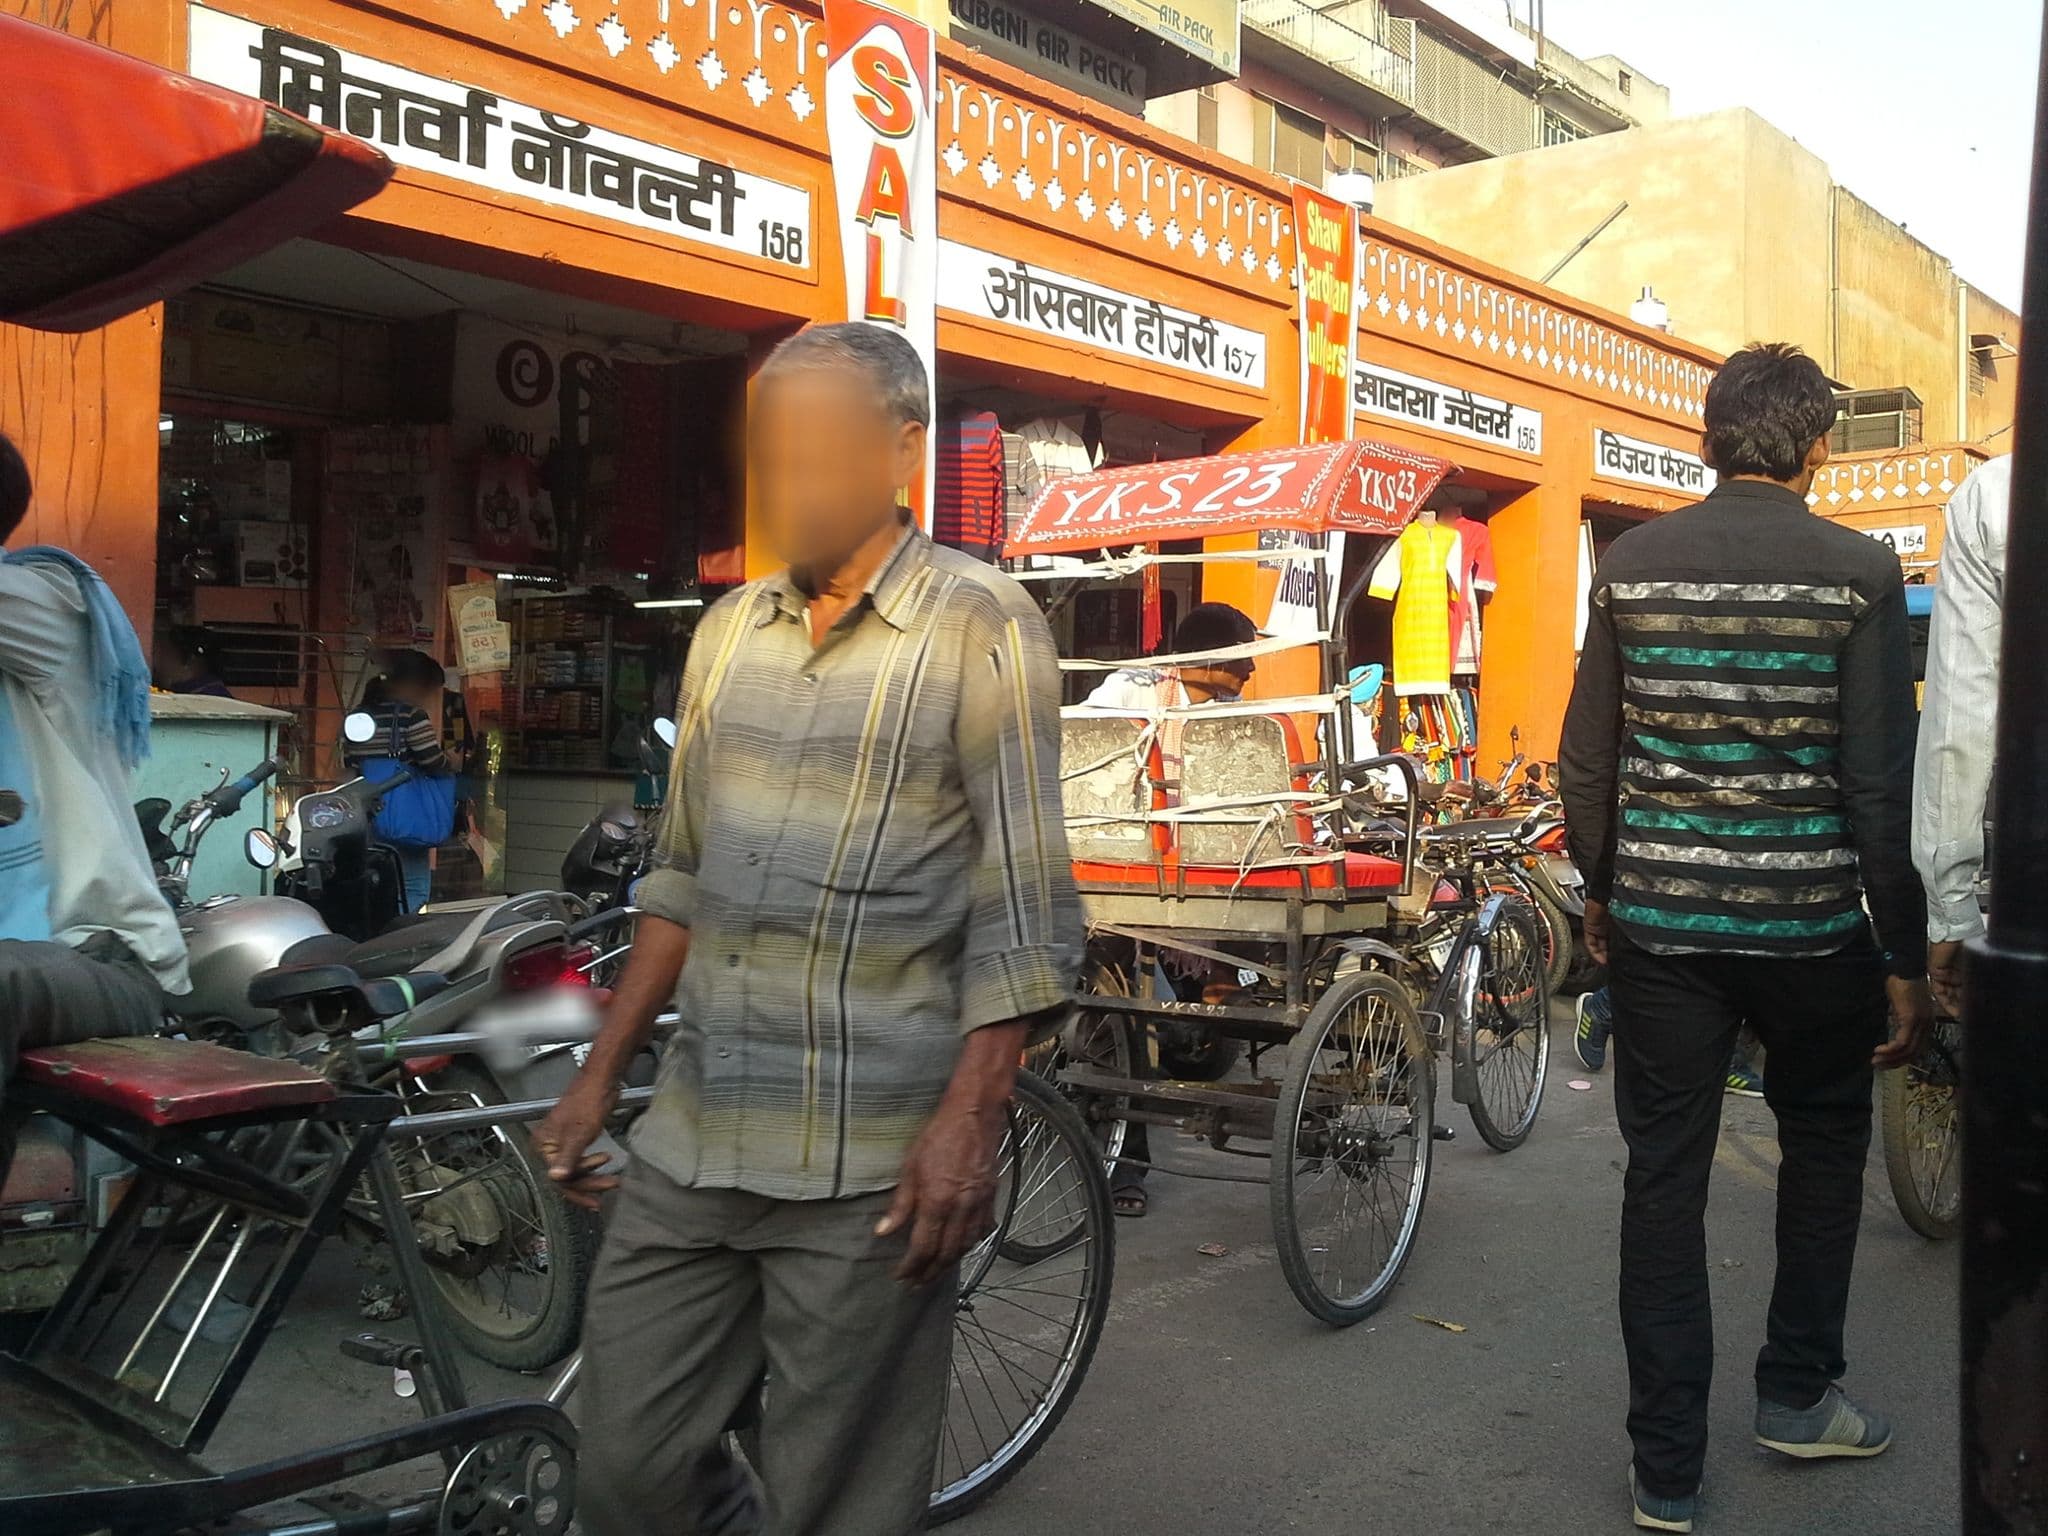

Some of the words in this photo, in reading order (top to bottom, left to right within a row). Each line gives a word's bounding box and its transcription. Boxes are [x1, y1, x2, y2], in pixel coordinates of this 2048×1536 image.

[1159, 4, 1180, 31] AIR
[1184, 16, 1214, 46] PACK
[1036, 27, 1070, 68] AIR
[1078, 46, 1135, 96] PACK
[758, 219, 803, 264] 158
[1306, 200, 1342, 256] Shaw
[1223, 344, 1257, 378] 157
[1354, 370, 1439, 421] खालसा
[1517, 425, 1537, 451] 156
[1600, 430, 1657, 477] विजय
[1659, 449, 1705, 488] फैशन
[1192, 461, 1297, 512] 23
[1396, 469, 1417, 502] 23
[1903, 534, 1924, 547] 154
